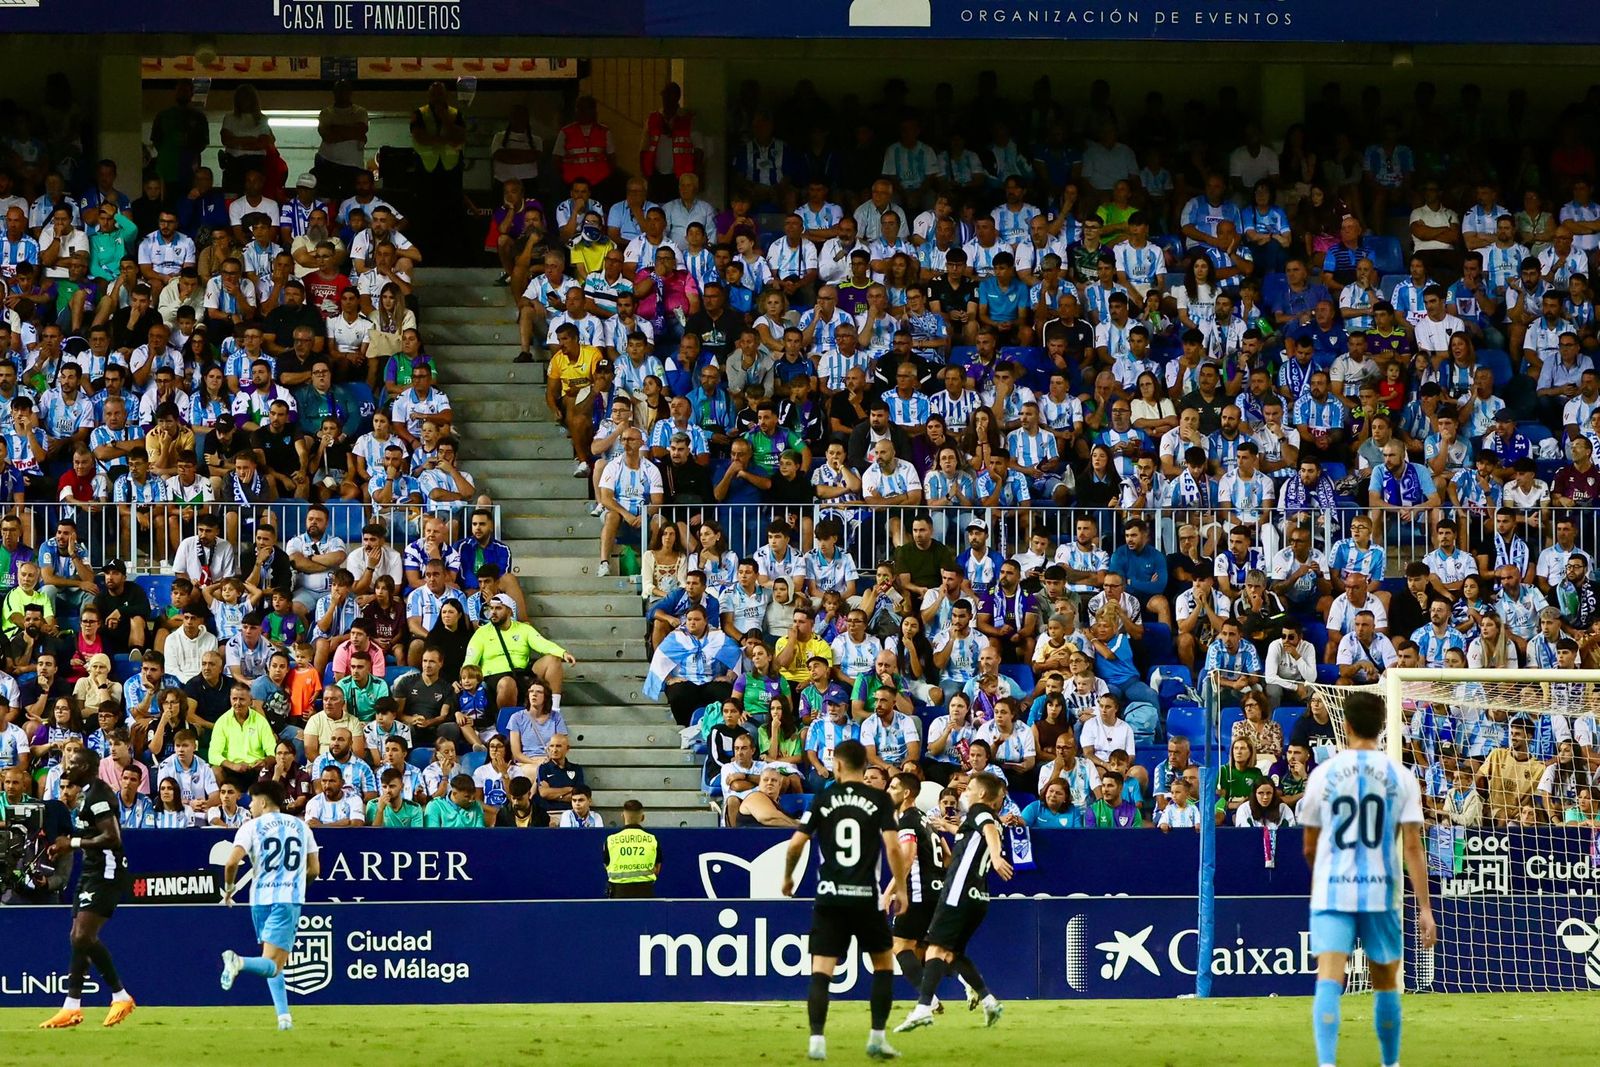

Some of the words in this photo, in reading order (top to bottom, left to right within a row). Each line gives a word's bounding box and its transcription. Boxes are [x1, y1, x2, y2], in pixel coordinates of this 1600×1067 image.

[283, 4, 324, 29] CASA
[335, 4, 353, 29] DE
[364, 4, 461, 30] PANADEROS
[960, 8, 1140, 23] ORGANIZACIÓN
[1155, 12, 1180, 24] DE
[1194, 12, 1294, 25] EVENTOS
[1332, 794, 1385, 850] 20
[610, 834, 653, 845] SEGURIDAD
[620, 846, 645, 856] 0072
[835, 818, 860, 867] 9
[263, 836, 302, 873] 26
[317, 846, 473, 881] ARPER
[133, 875, 214, 897] #FANCAM
[346, 930, 432, 951] Ciudad
[1168, 929, 1368, 975] Caixa
[347, 958, 377, 979] de
[384, 958, 469, 983] Málaga
